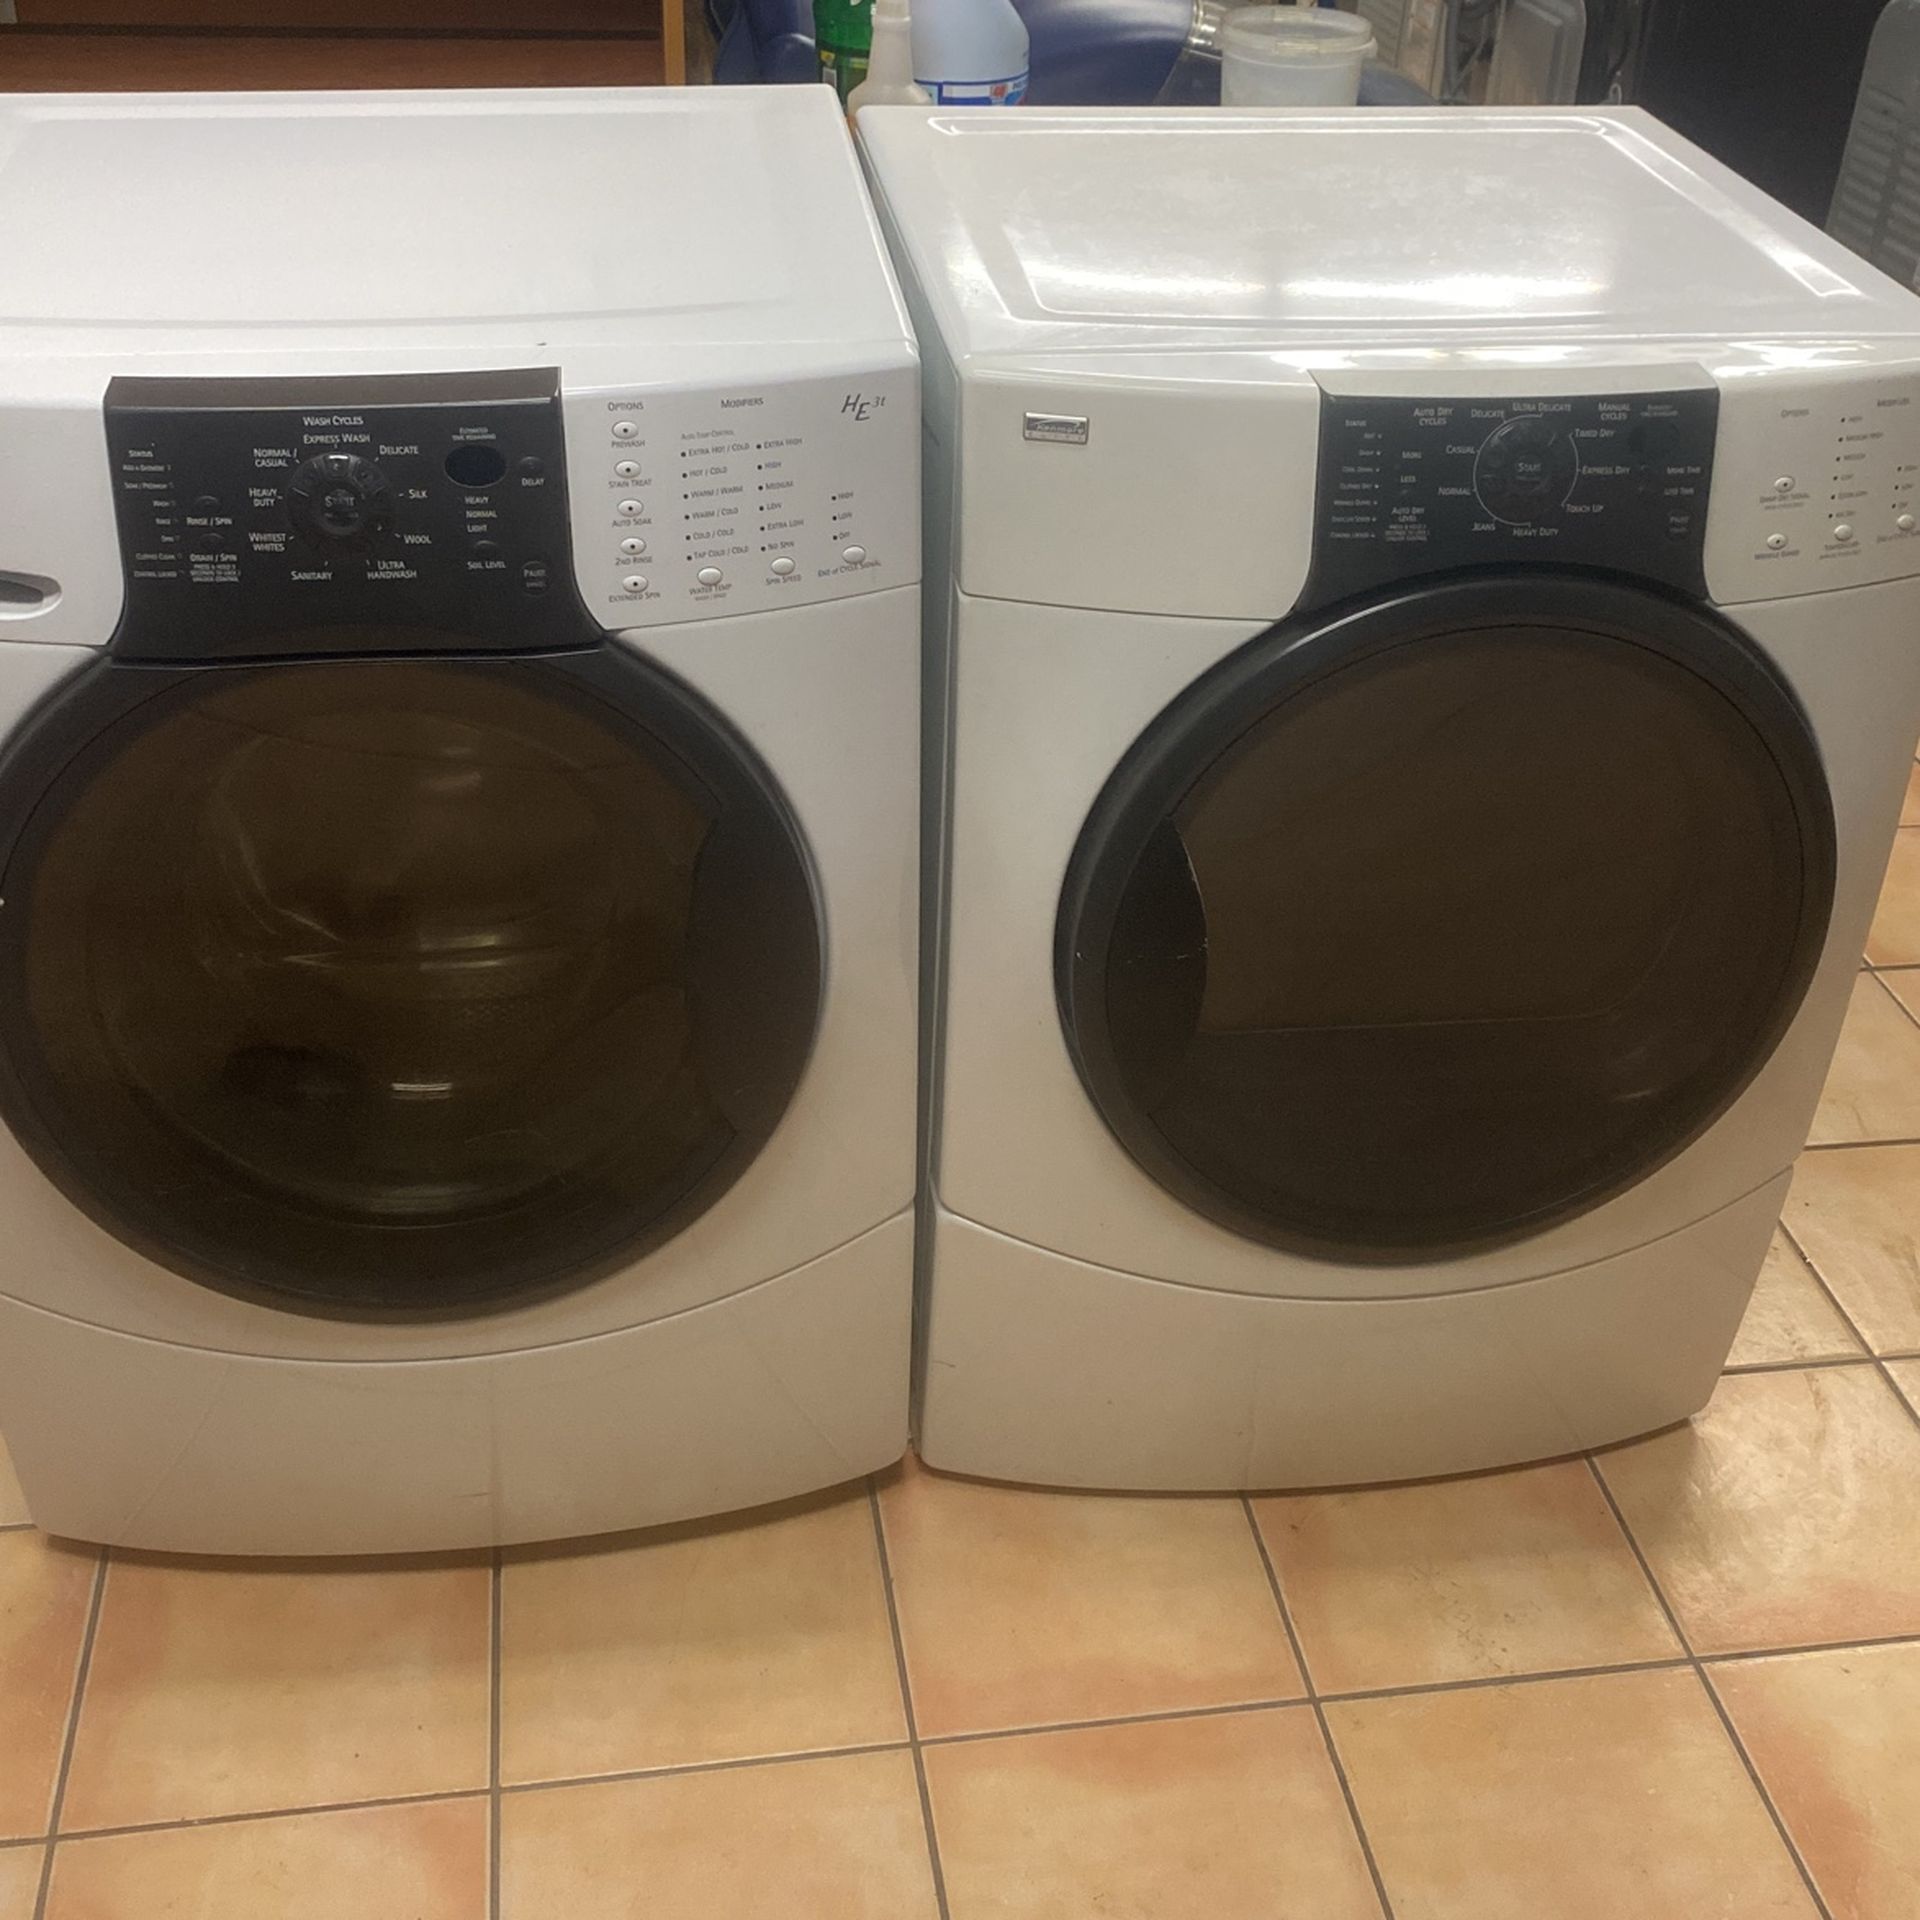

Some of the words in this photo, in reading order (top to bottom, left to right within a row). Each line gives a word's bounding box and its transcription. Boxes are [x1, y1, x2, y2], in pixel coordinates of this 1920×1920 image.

[608, 402, 644, 411] OPTIONS
[721, 397, 764, 408] MODIFIERS
[303, 416, 331, 426] WASH
[332, 416, 364, 425] CYCLES
[304, 434, 340, 444] EXPRESS
[341, 433, 370, 443] WASH
[253, 448, 291, 458] NORMAL
[379, 445, 419, 454] DELICATE
[255, 458, 288, 467] CASUAL
[249, 488, 277, 497] HEAVY
[409, 490, 428, 499] SILK
[253, 498, 276, 507] DUTY
[249, 533, 286, 542] WHITEST
[404, 535, 432, 544] WOOL
[253, 543, 285, 552] WHITES
[377, 560, 406, 570] ULTRA
[291, 571, 333, 580] SANITARY
[367, 570, 417, 579] HANDWASH
